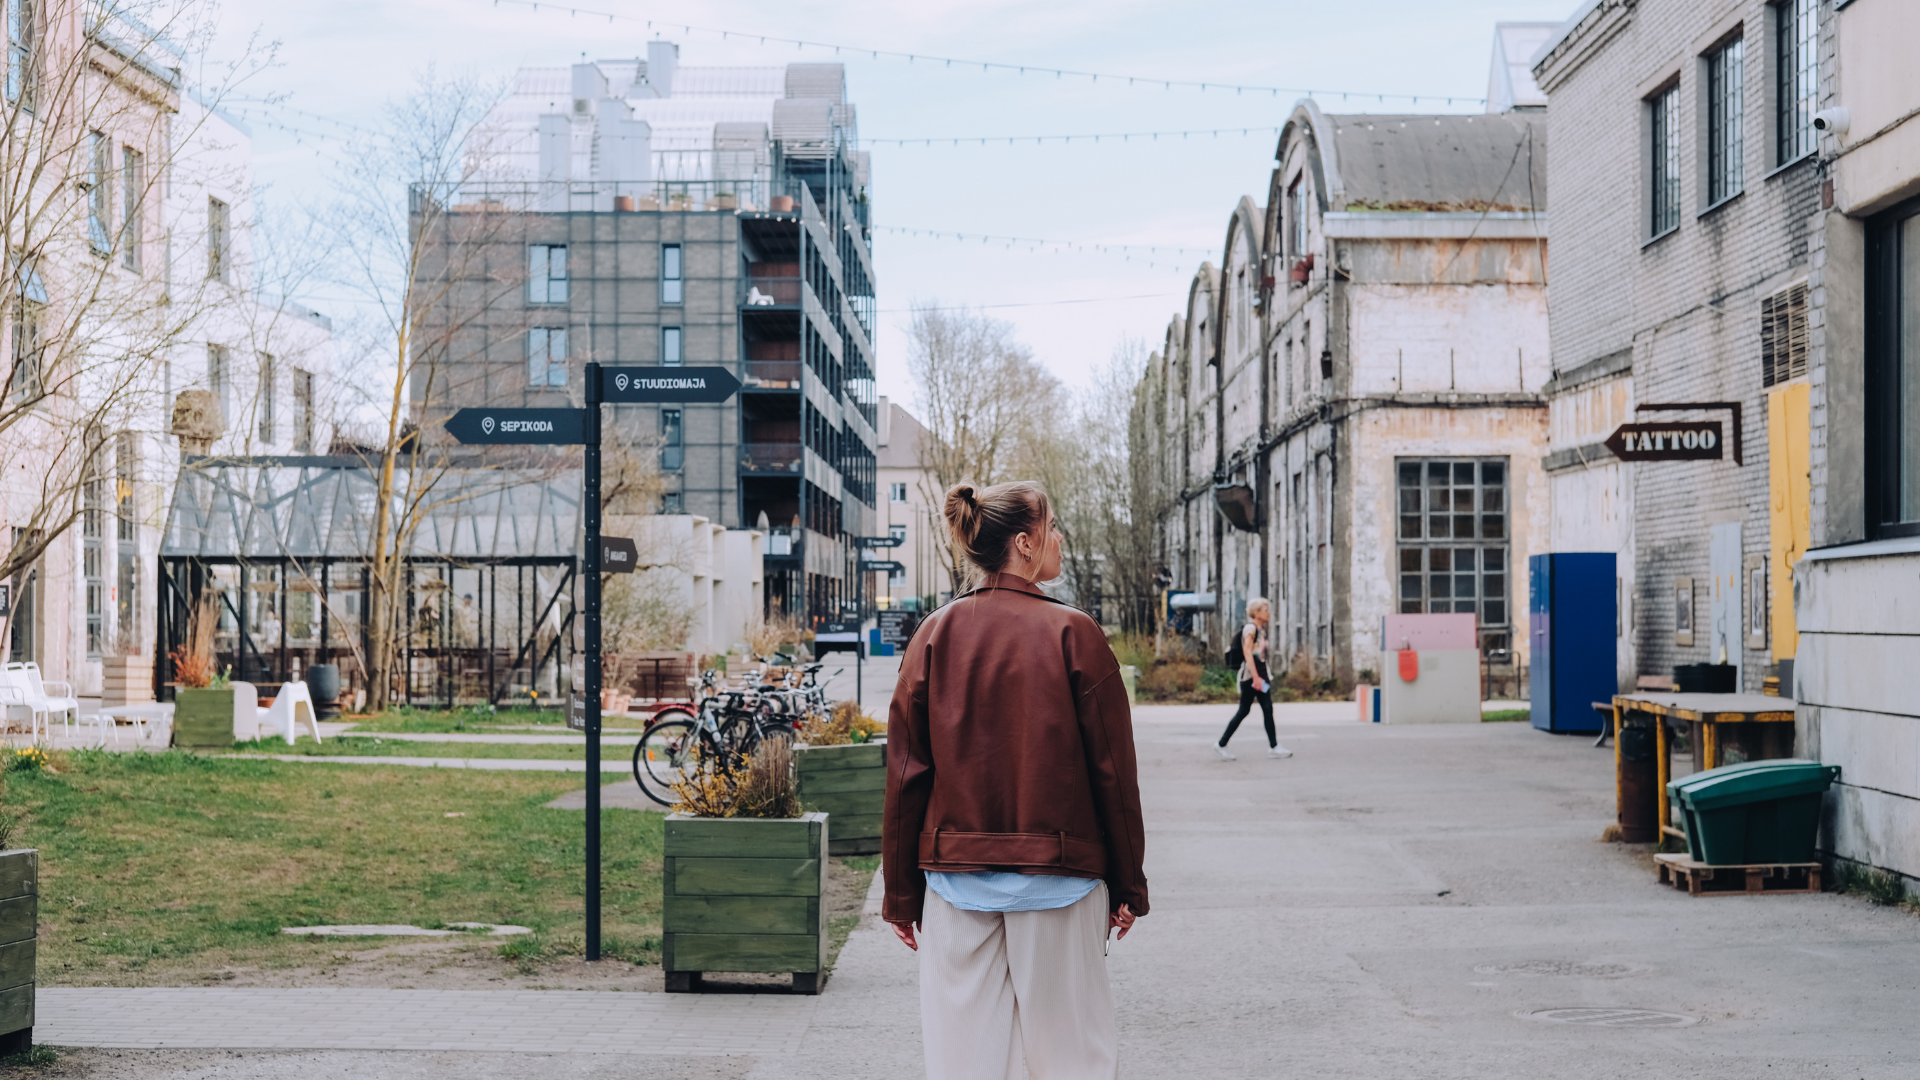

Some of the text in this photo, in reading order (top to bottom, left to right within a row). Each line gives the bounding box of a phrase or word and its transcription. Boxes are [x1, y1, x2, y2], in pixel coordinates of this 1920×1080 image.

[633, 377, 707, 390] STUUDIOMAJA
[500, 420, 554, 432] SEPIKODA
[1621, 429, 1717, 452] TATTOO
